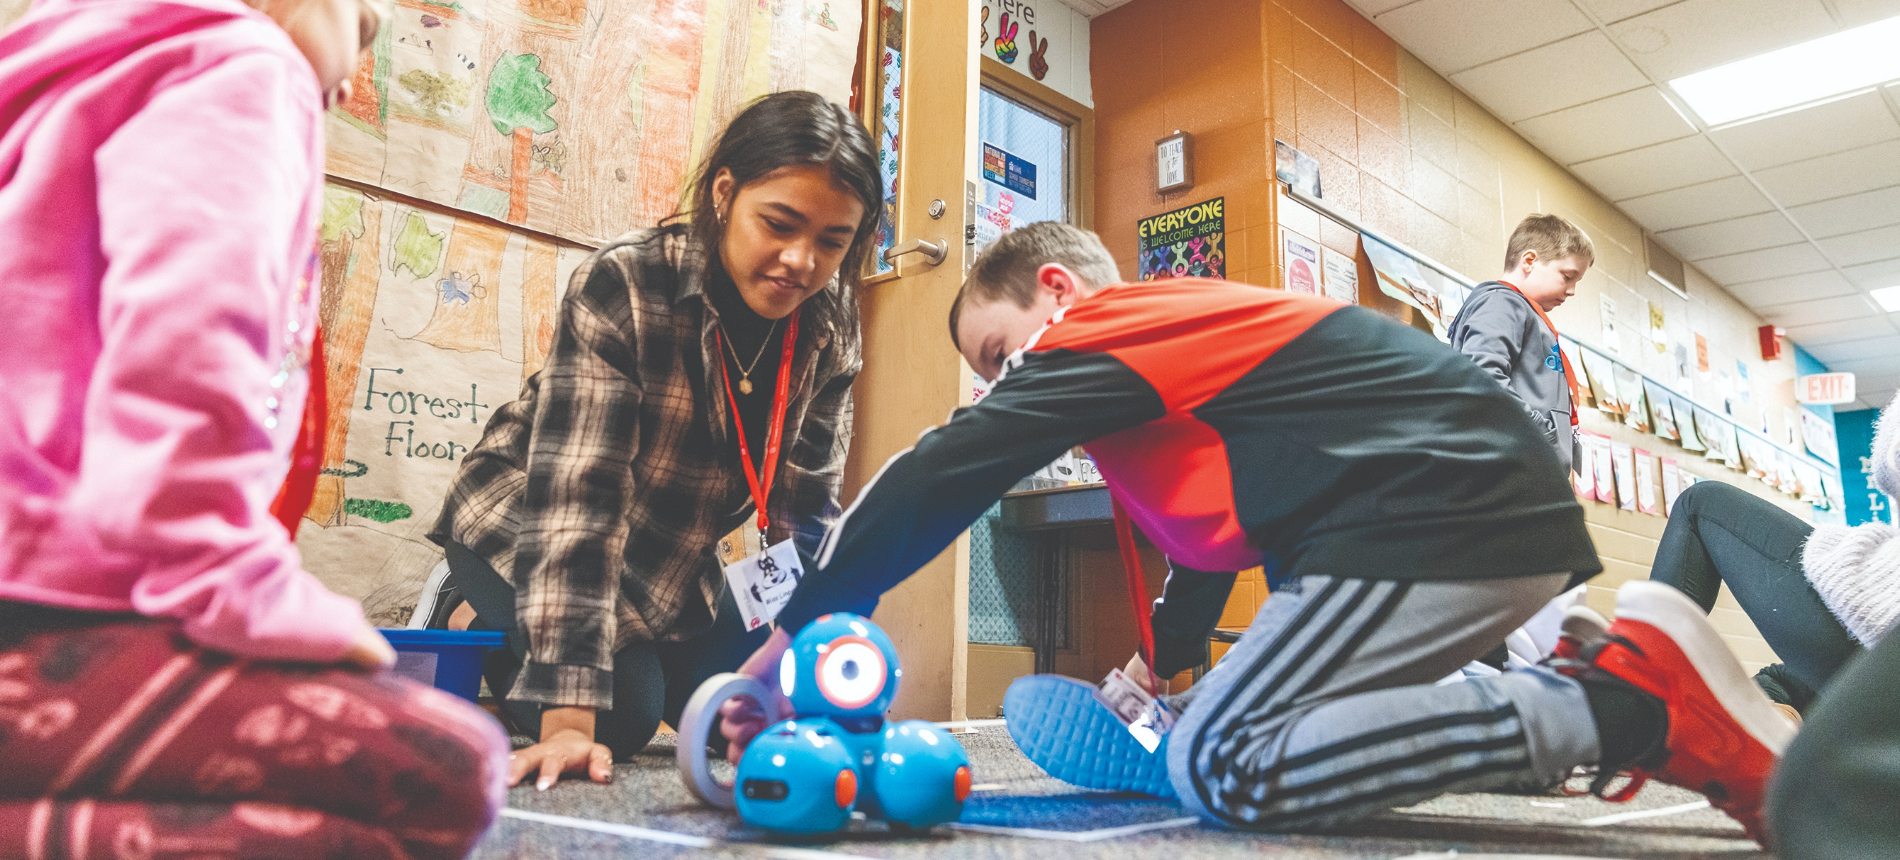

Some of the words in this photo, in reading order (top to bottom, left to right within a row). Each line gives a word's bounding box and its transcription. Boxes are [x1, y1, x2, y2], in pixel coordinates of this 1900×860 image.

[988, 0, 1035, 25] ere
[1139, 199, 1222, 238] EVERYONE
[1140, 239, 1148, 250] IS
[1151, 227, 1194, 248] WELCOME
[1198, 219, 1221, 235] HERE
[363, 367, 489, 424] Forest
[1807, 375, 1845, 401] EXIT
[385, 420, 467, 461] Floor
